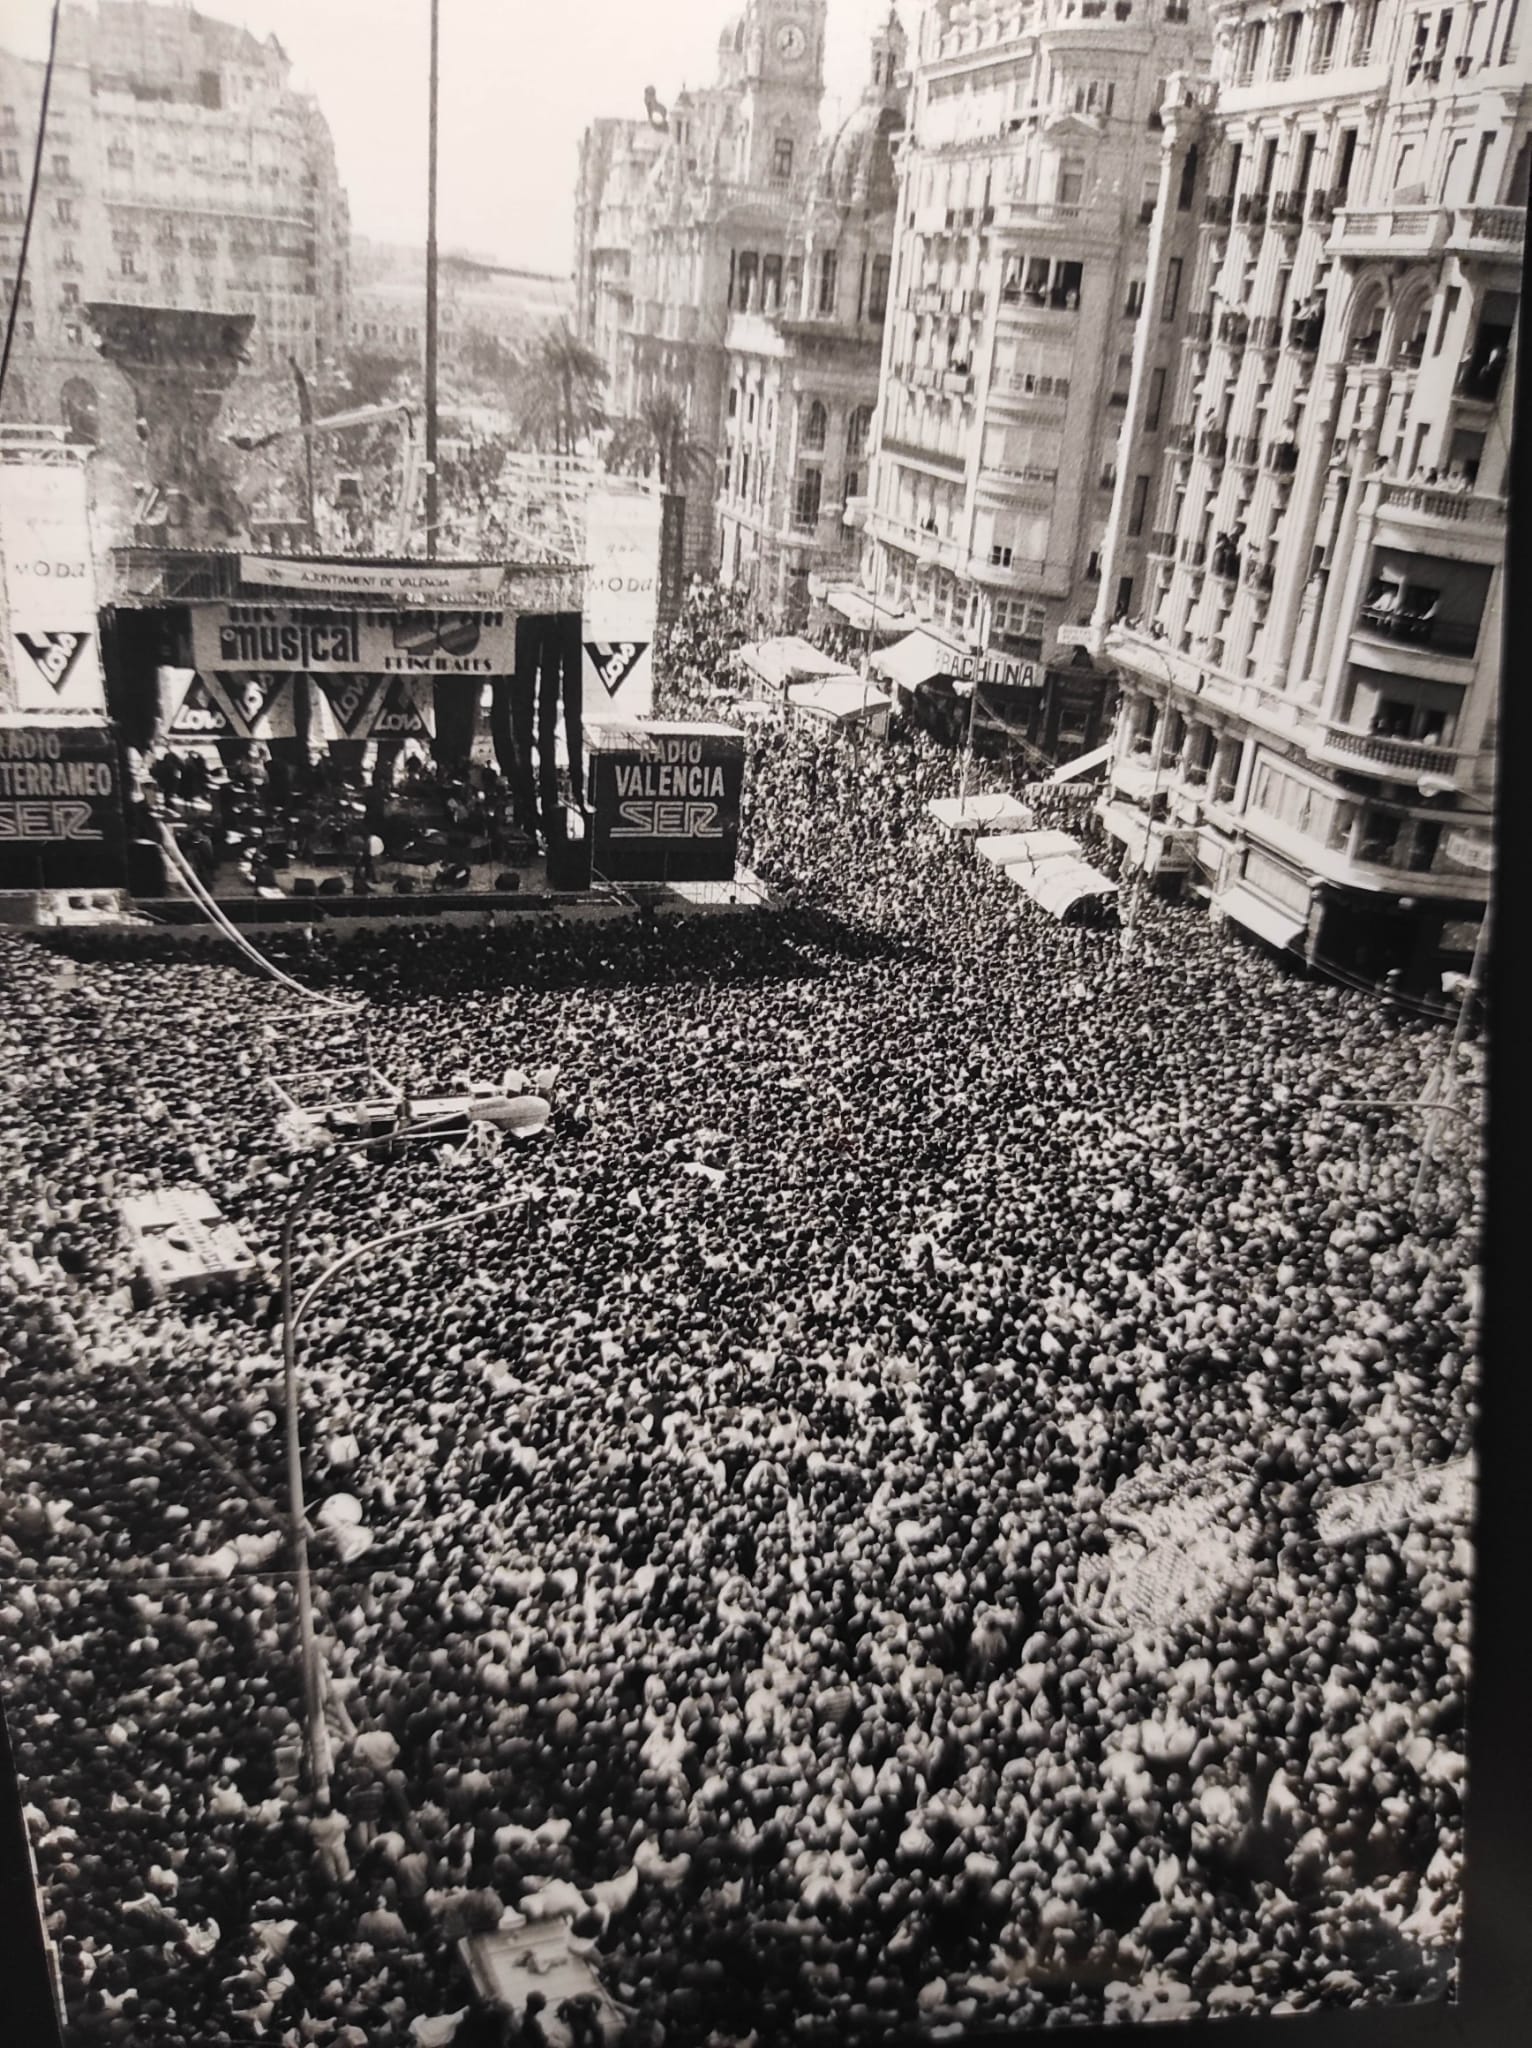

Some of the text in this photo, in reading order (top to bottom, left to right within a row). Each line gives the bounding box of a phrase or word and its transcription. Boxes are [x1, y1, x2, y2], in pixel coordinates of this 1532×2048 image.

[302, 572, 376, 588] AJUNTAMENT
[640, 740, 702, 763] RADIO
[615, 765, 725, 797] VALENCIA
[609, 801, 723, 838] SER
